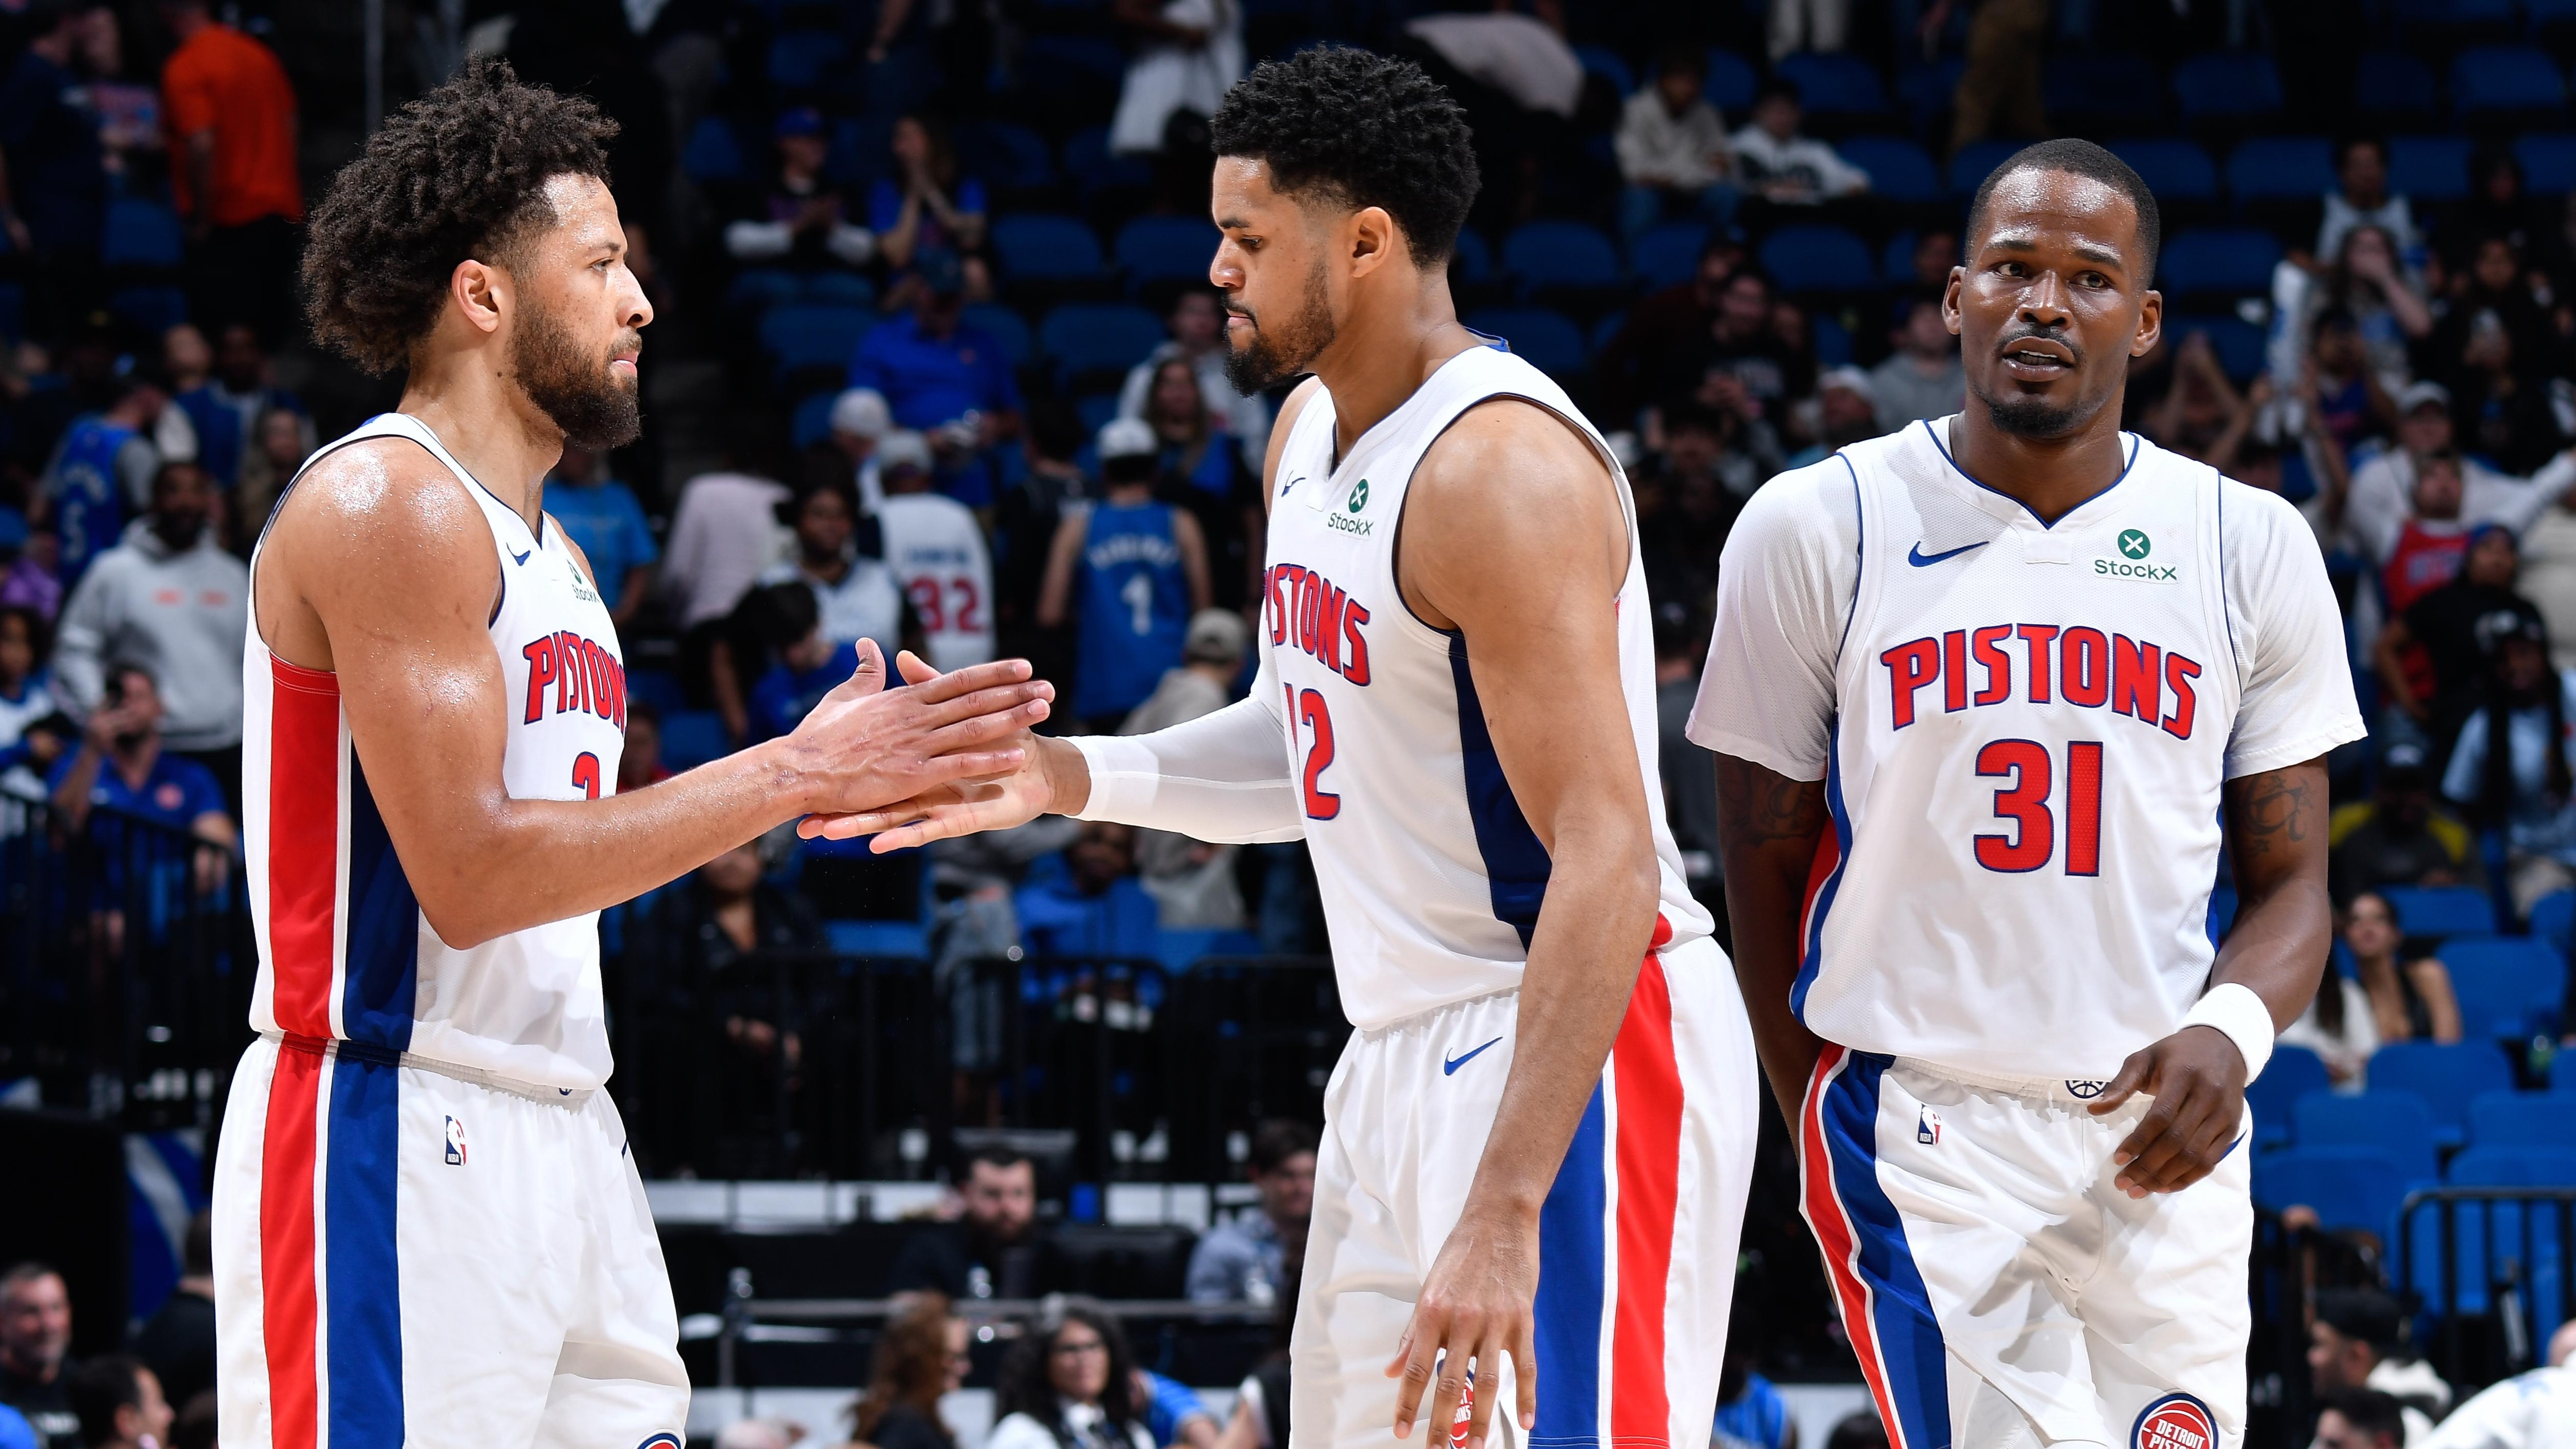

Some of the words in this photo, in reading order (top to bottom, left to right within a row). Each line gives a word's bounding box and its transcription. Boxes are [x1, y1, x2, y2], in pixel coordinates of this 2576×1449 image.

[1328, 512, 1374, 536] StockX
[2094, 559, 2178, 581] StockX
[1120, 574, 1153, 636] 1
[1263, 563, 1371, 687] ISTONS
[522, 630, 628, 739] PISTON
[1880, 622, 2202, 741] PISTONS
[1973, 738, 2104, 878] 31
[447, 1153, 460, 1163] NBA
[2148, 1433, 2192, 1449] PIST
[2155, 1418, 2206, 1449] DETROIT
